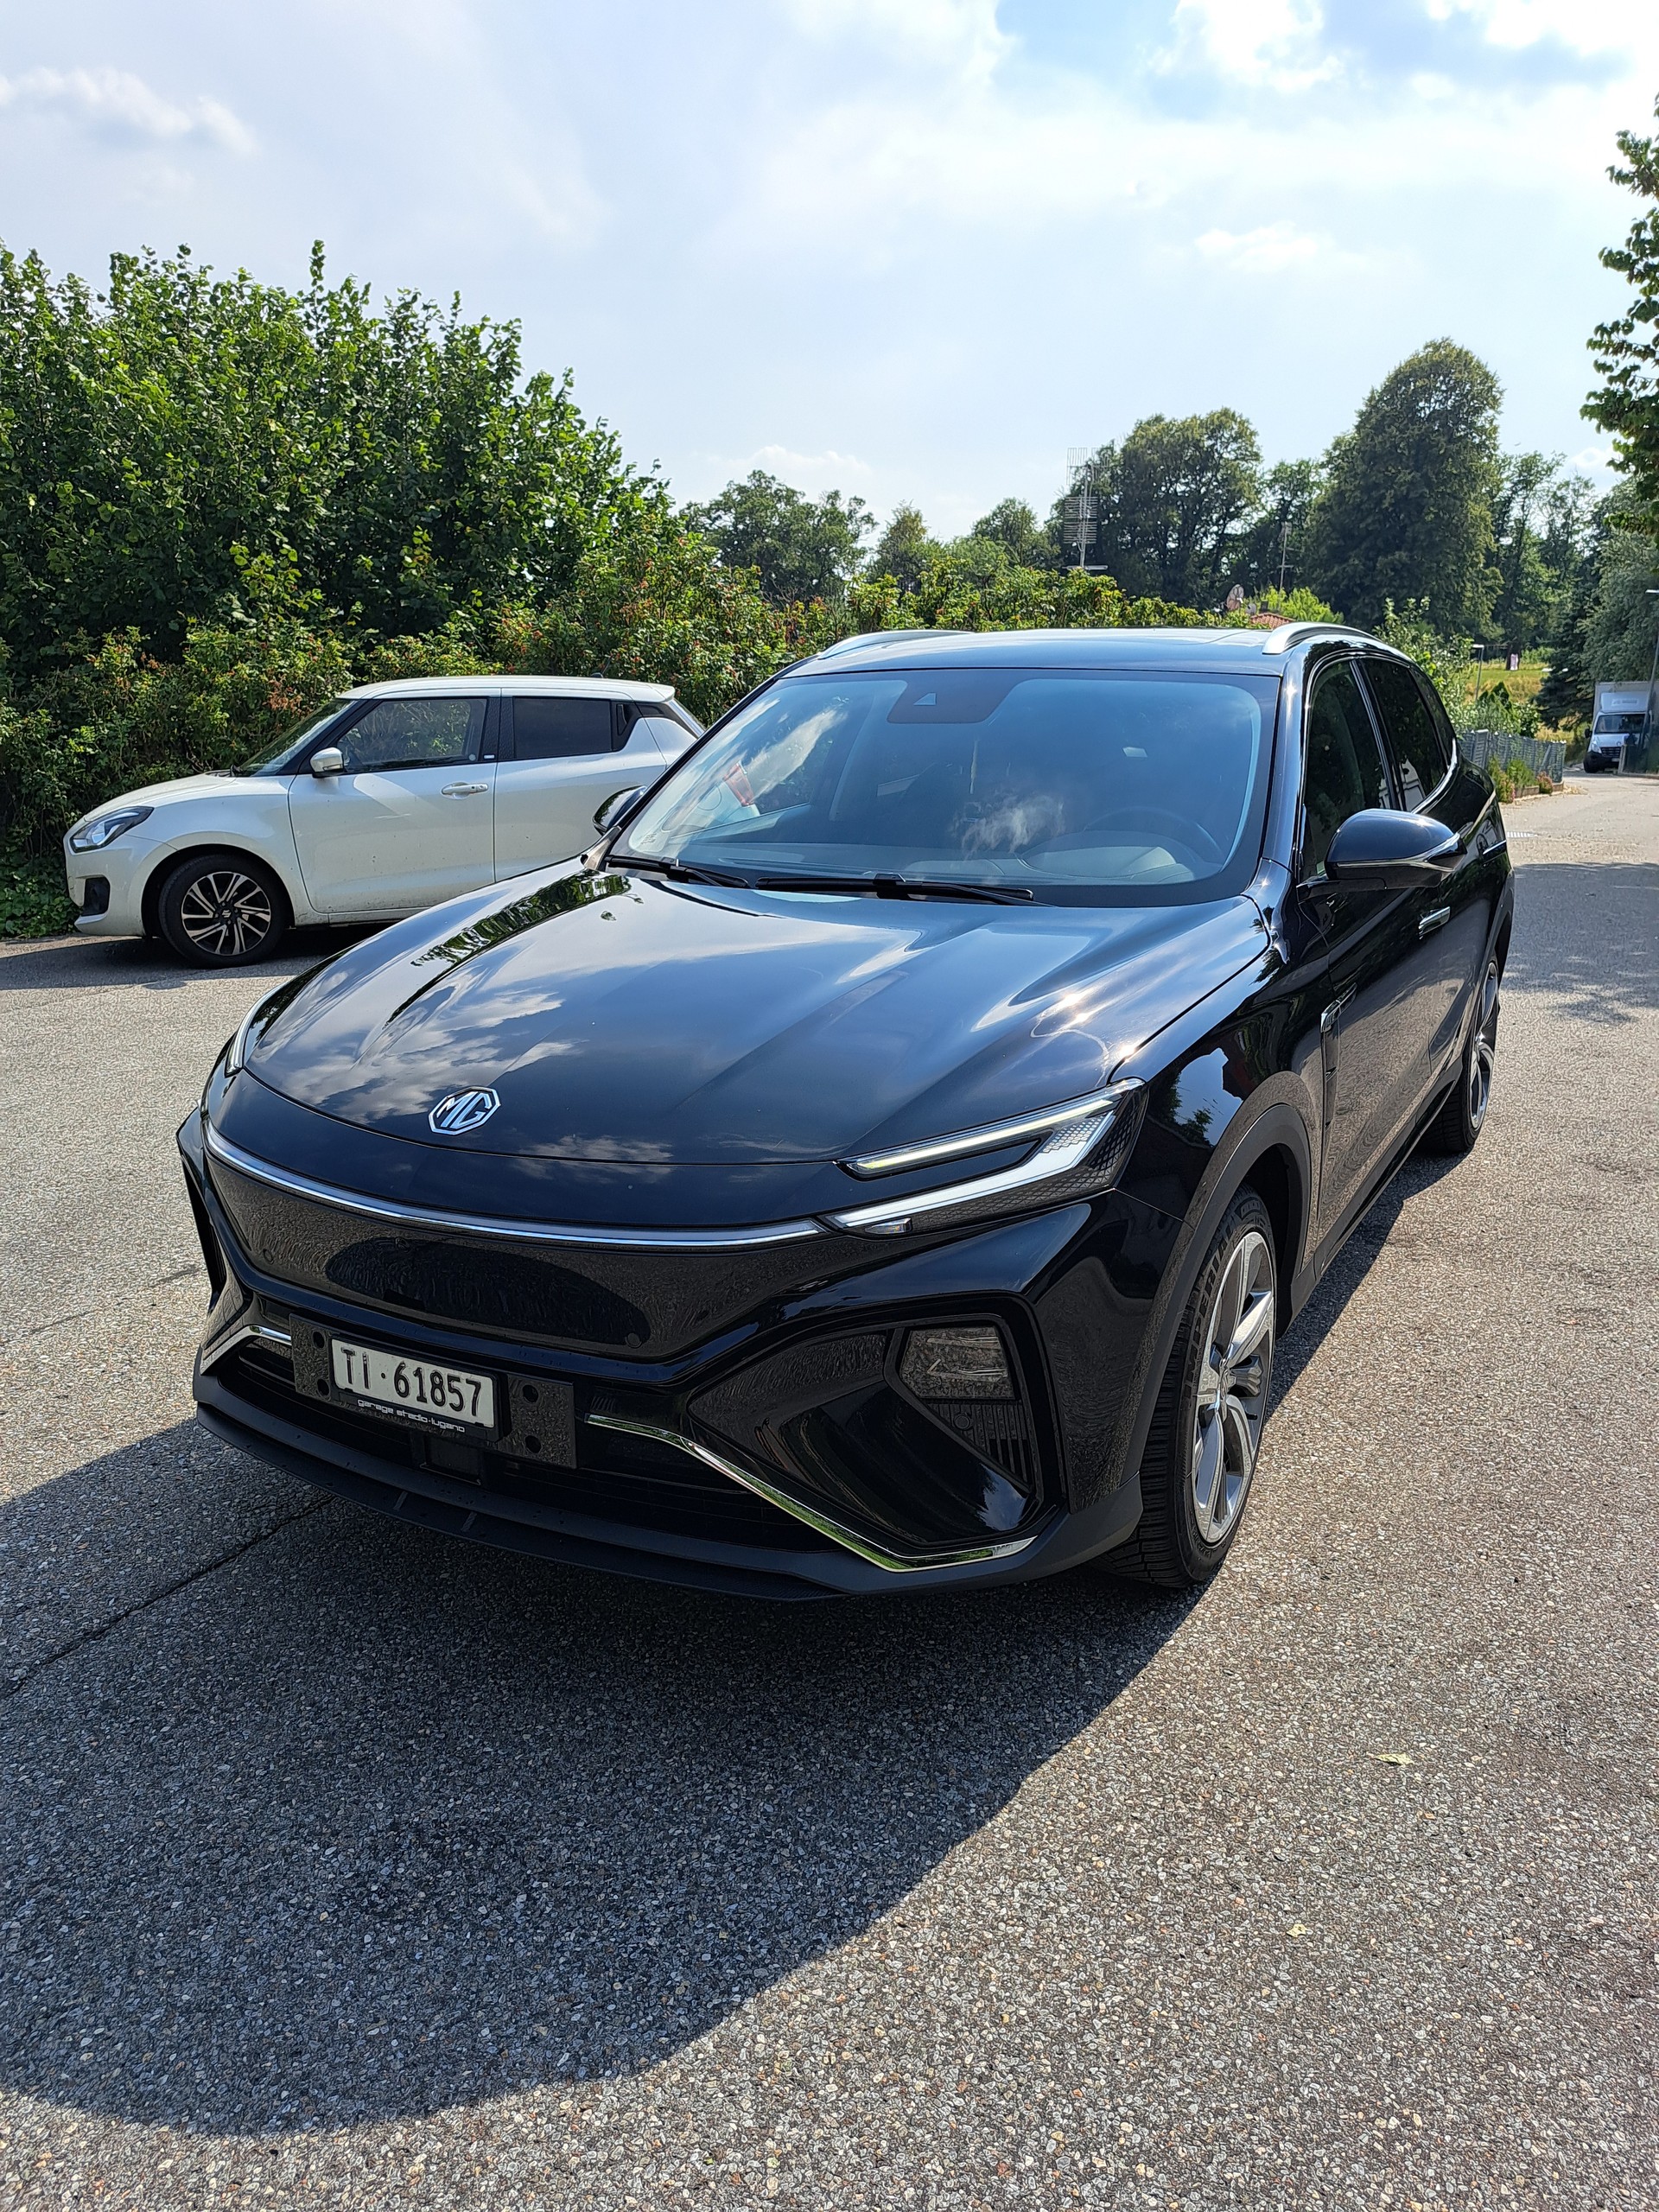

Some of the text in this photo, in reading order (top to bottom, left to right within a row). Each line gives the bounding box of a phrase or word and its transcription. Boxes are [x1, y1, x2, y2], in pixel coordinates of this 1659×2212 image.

[436, 1091, 493, 1128] MG
[357, 1399, 394, 1414] garage
[394, 1361, 481, 1417] 61857
